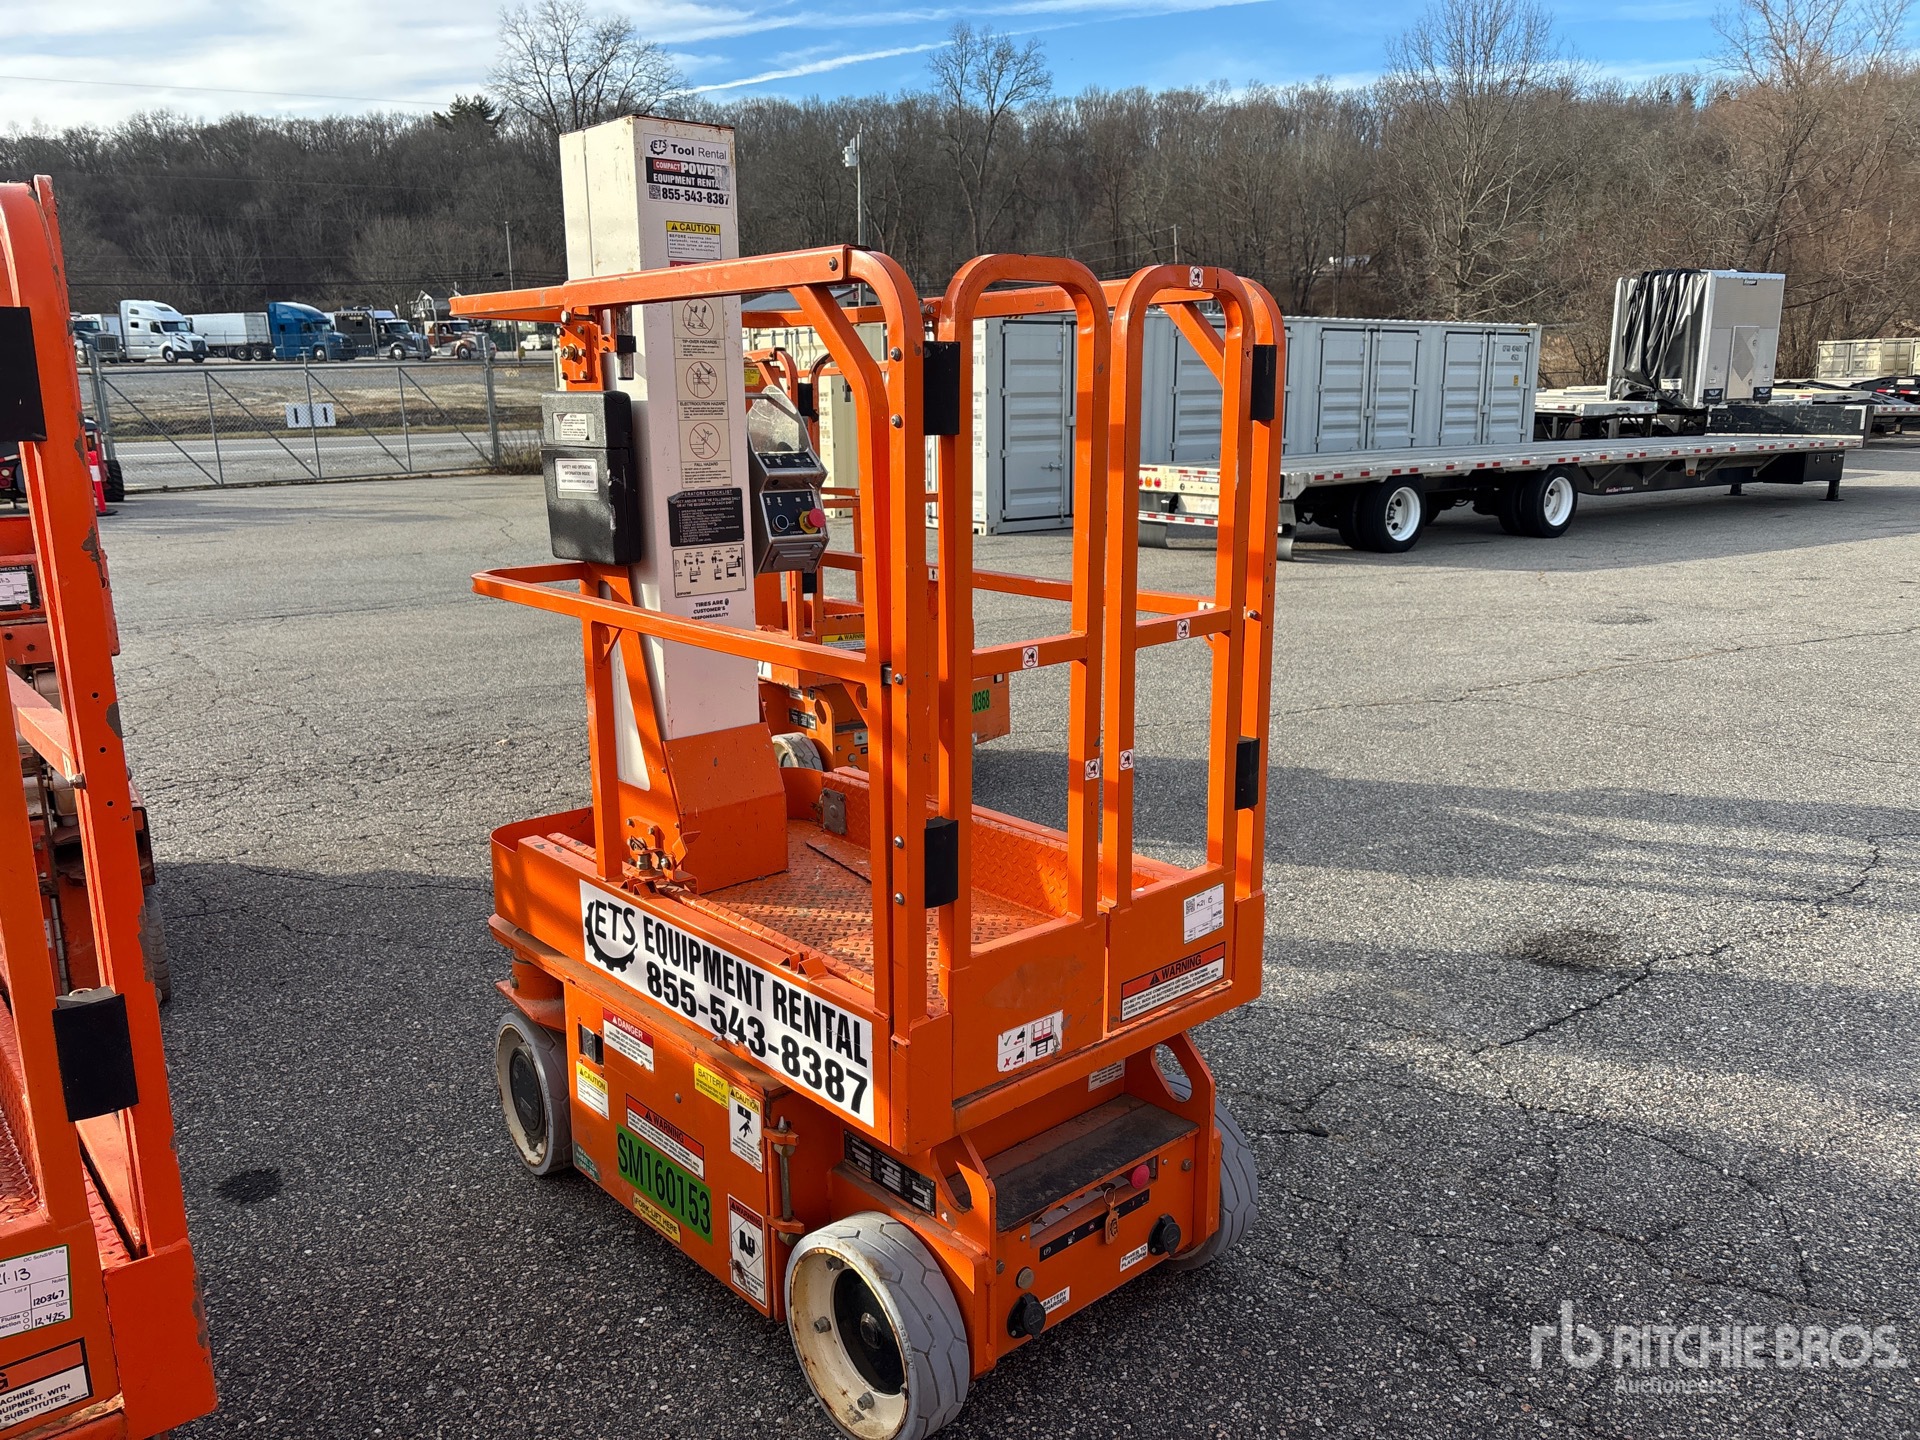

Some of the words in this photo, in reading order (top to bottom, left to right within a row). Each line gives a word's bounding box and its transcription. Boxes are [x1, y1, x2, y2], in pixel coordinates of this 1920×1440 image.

[653, 140, 667, 148] ETS
[671, 144, 694, 155] Tool
[698, 148, 726, 160] Rental
[656, 162, 680, 170] COMPACT
[681, 162, 722, 177] POWER
[653, 174, 695, 185] EQUIPMENT
[697, 178, 723, 189] RENTAL
[662, 188, 729, 205] 855-543-8387
[680, 223, 716, 232] CAUTION
[693, 606, 725, 614] CUSTOMER'S
[1161, 955, 1201, 979] WARNING
[596, 900, 638, 946] ETS
[643, 916, 764, 1012] EQUIPMENT
[772, 979, 868, 1068] RENTAL
[618, 1018, 643, 1040] DANGER
[646, 961, 868, 1114] 855-543-8387
[584, 1070, 605, 1091] CAUTION
[698, 1068, 724, 1090] BATTERY
[735, 1092, 759, 1111] CAUTION
[653, 1113, 684, 1144] WARNING
[617, 1133, 711, 1235] SM160153
[663, 1218, 677, 1234] HERE
[1121, 1252, 1146, 1268] PLATFORM
[1122, 1250, 1139, 1262] POWER
[33, 1290, 64, 1306] 120367
[1043, 1290, 1067, 1306] BATTERY
[0, 1388, 35, 1406] ACHINE
[47, 1383, 70, 1396] WITH
[5, 1393, 69, 1422] SUBSTITUTES.
